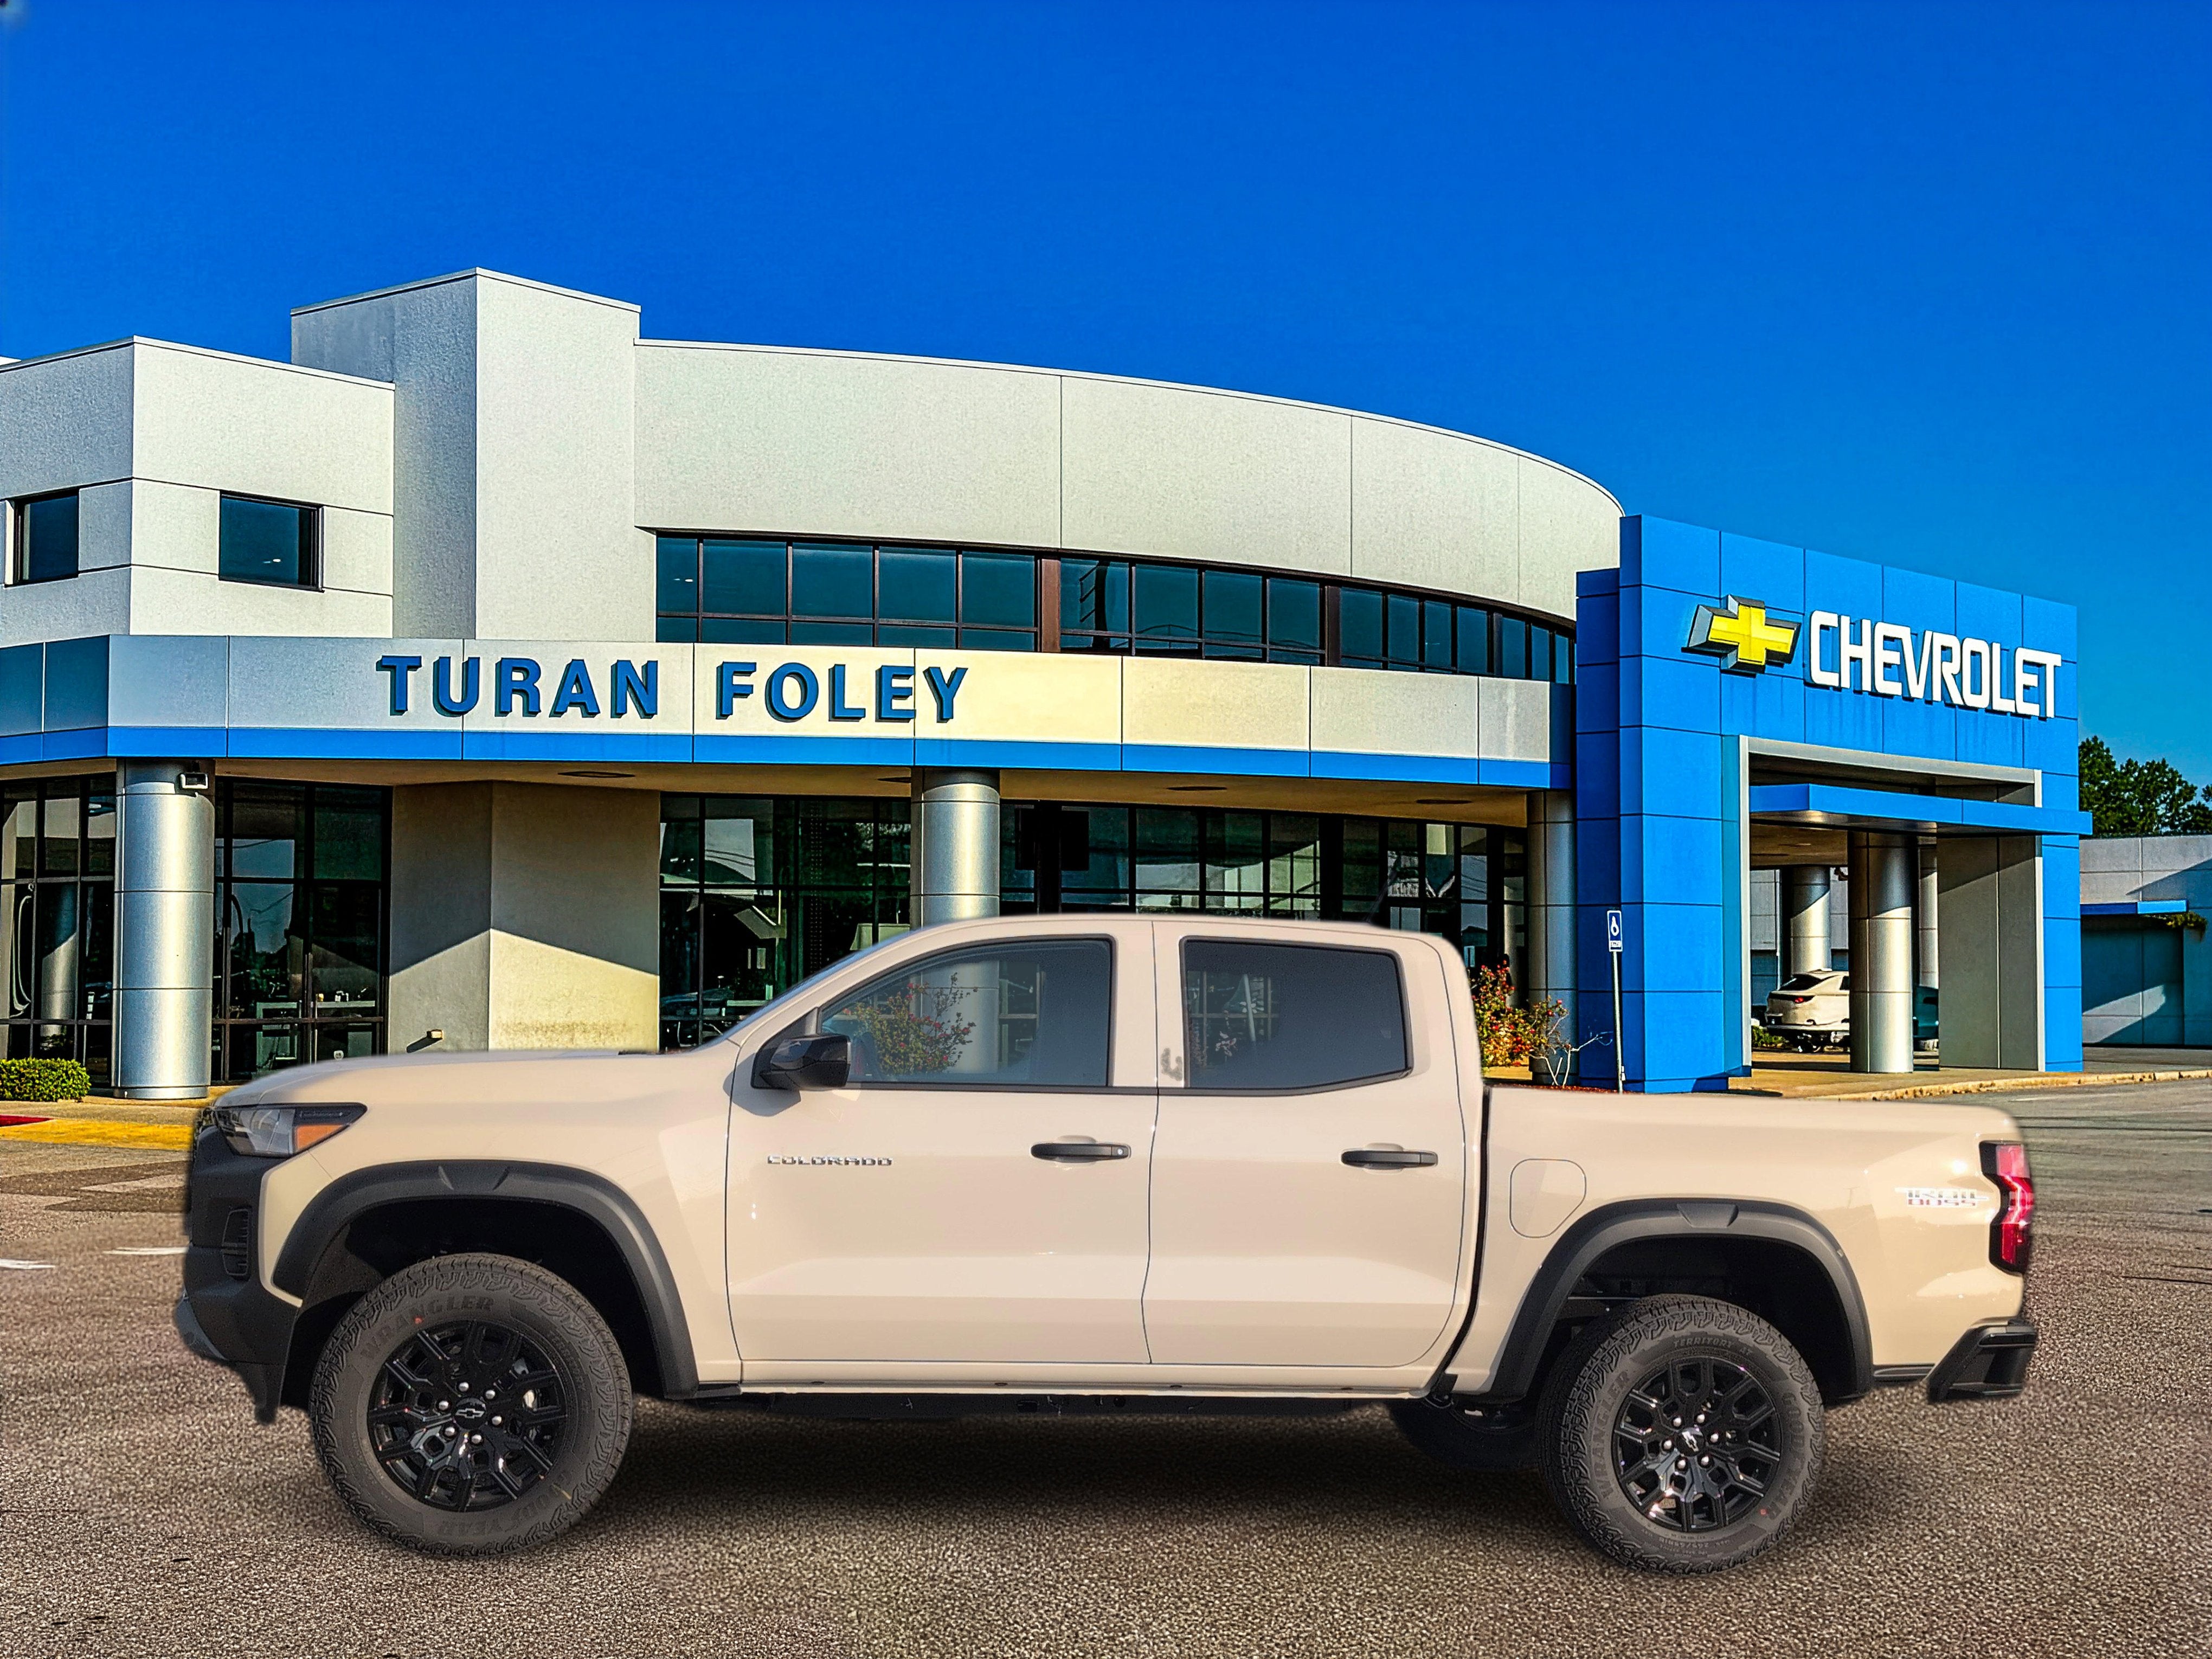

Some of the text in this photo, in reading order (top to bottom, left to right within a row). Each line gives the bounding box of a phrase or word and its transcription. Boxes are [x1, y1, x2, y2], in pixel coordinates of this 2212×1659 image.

[376, 656, 968, 723] TURAN FOLEY
[1809, 609, 2062, 718] CHEVROLET
[767, 1155, 893, 1166] COLORADO
[1673, 1336, 1735, 1348] TERRITORY
[1592, 1371, 1629, 1499] WRANGLER
